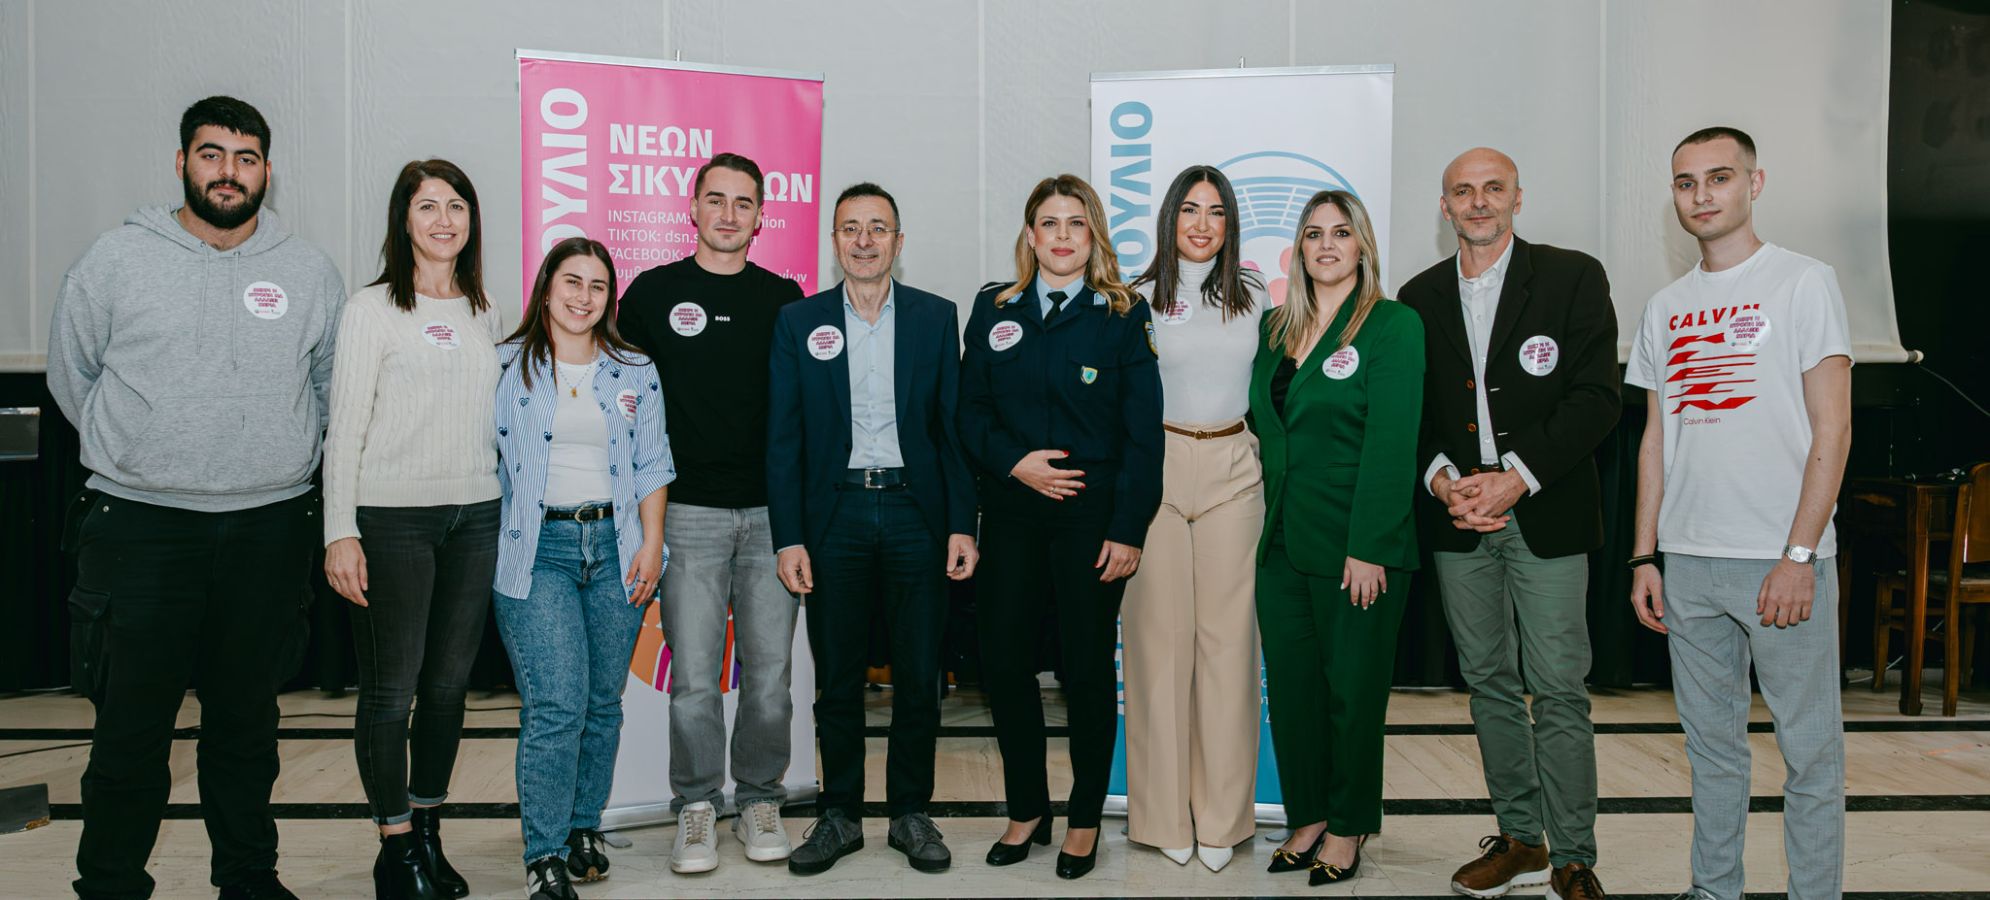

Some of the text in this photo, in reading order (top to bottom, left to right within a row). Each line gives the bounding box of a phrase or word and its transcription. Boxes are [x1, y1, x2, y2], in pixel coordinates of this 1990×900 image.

[609, 123, 713, 159] ΝΕΩΝ
[608, 163, 813, 203] ΣΙΚΥΩΝ
[1109, 100, 1153, 284] ΟΥΛΙΟ
[607, 209, 691, 225] INSTAGRAM:
[607, 228, 662, 242] TIKTOK:
[608, 247, 684, 261] FACEBOOK:
[1683, 416, 1703, 426] Calvin
